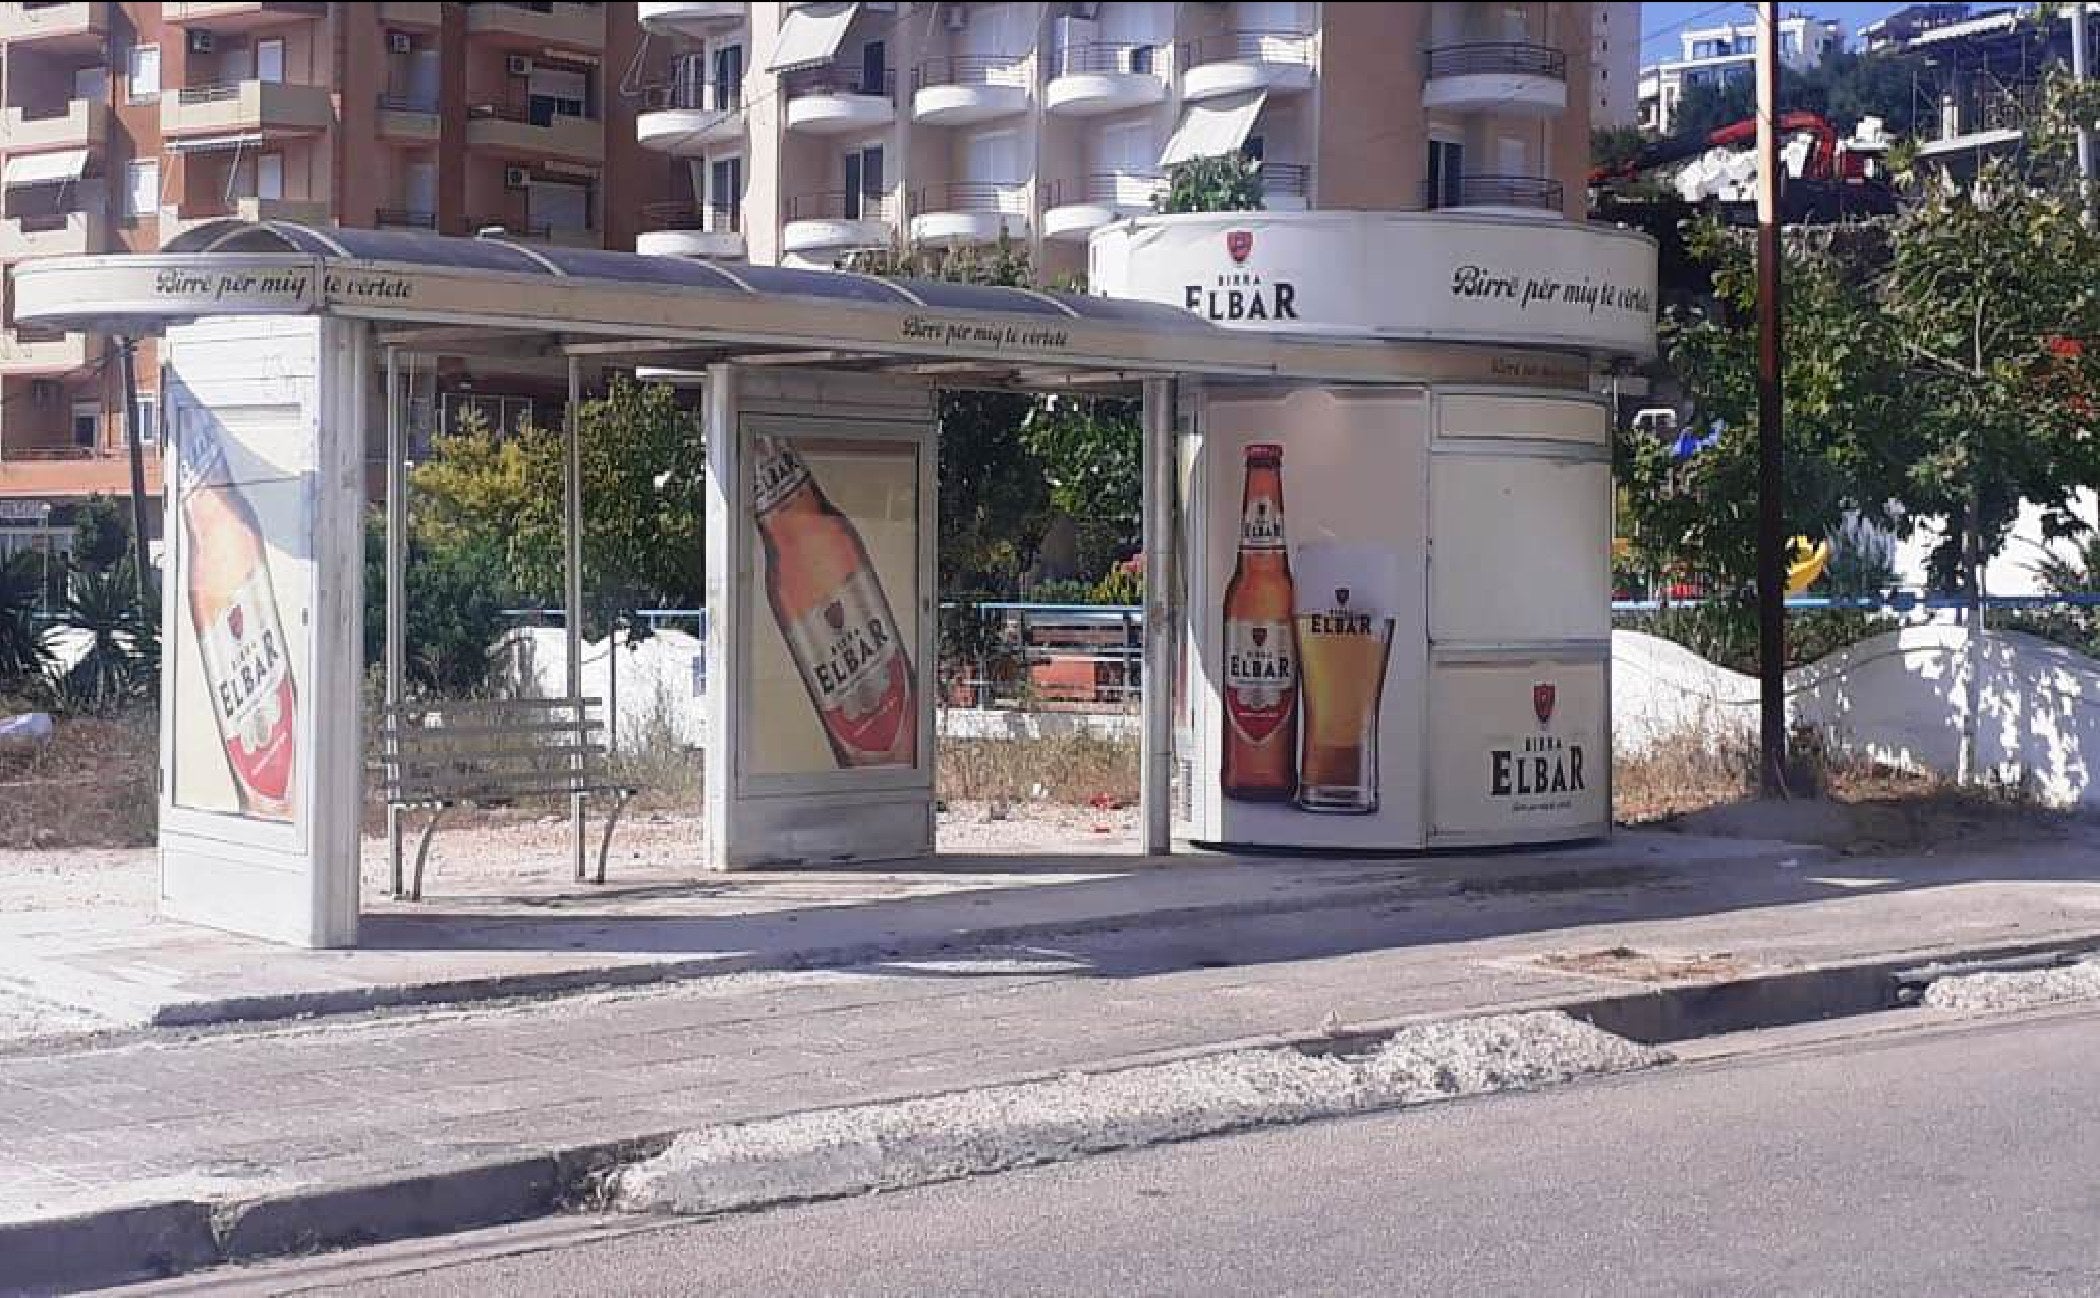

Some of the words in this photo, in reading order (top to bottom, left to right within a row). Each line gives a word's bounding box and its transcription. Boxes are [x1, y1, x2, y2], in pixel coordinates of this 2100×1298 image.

[217, 629, 280, 719] ELBAR
[813, 617, 889, 695] ELBAR
[1230, 654, 1291, 679] ELBAR
[1491, 745, 1586, 796] ELBAR
